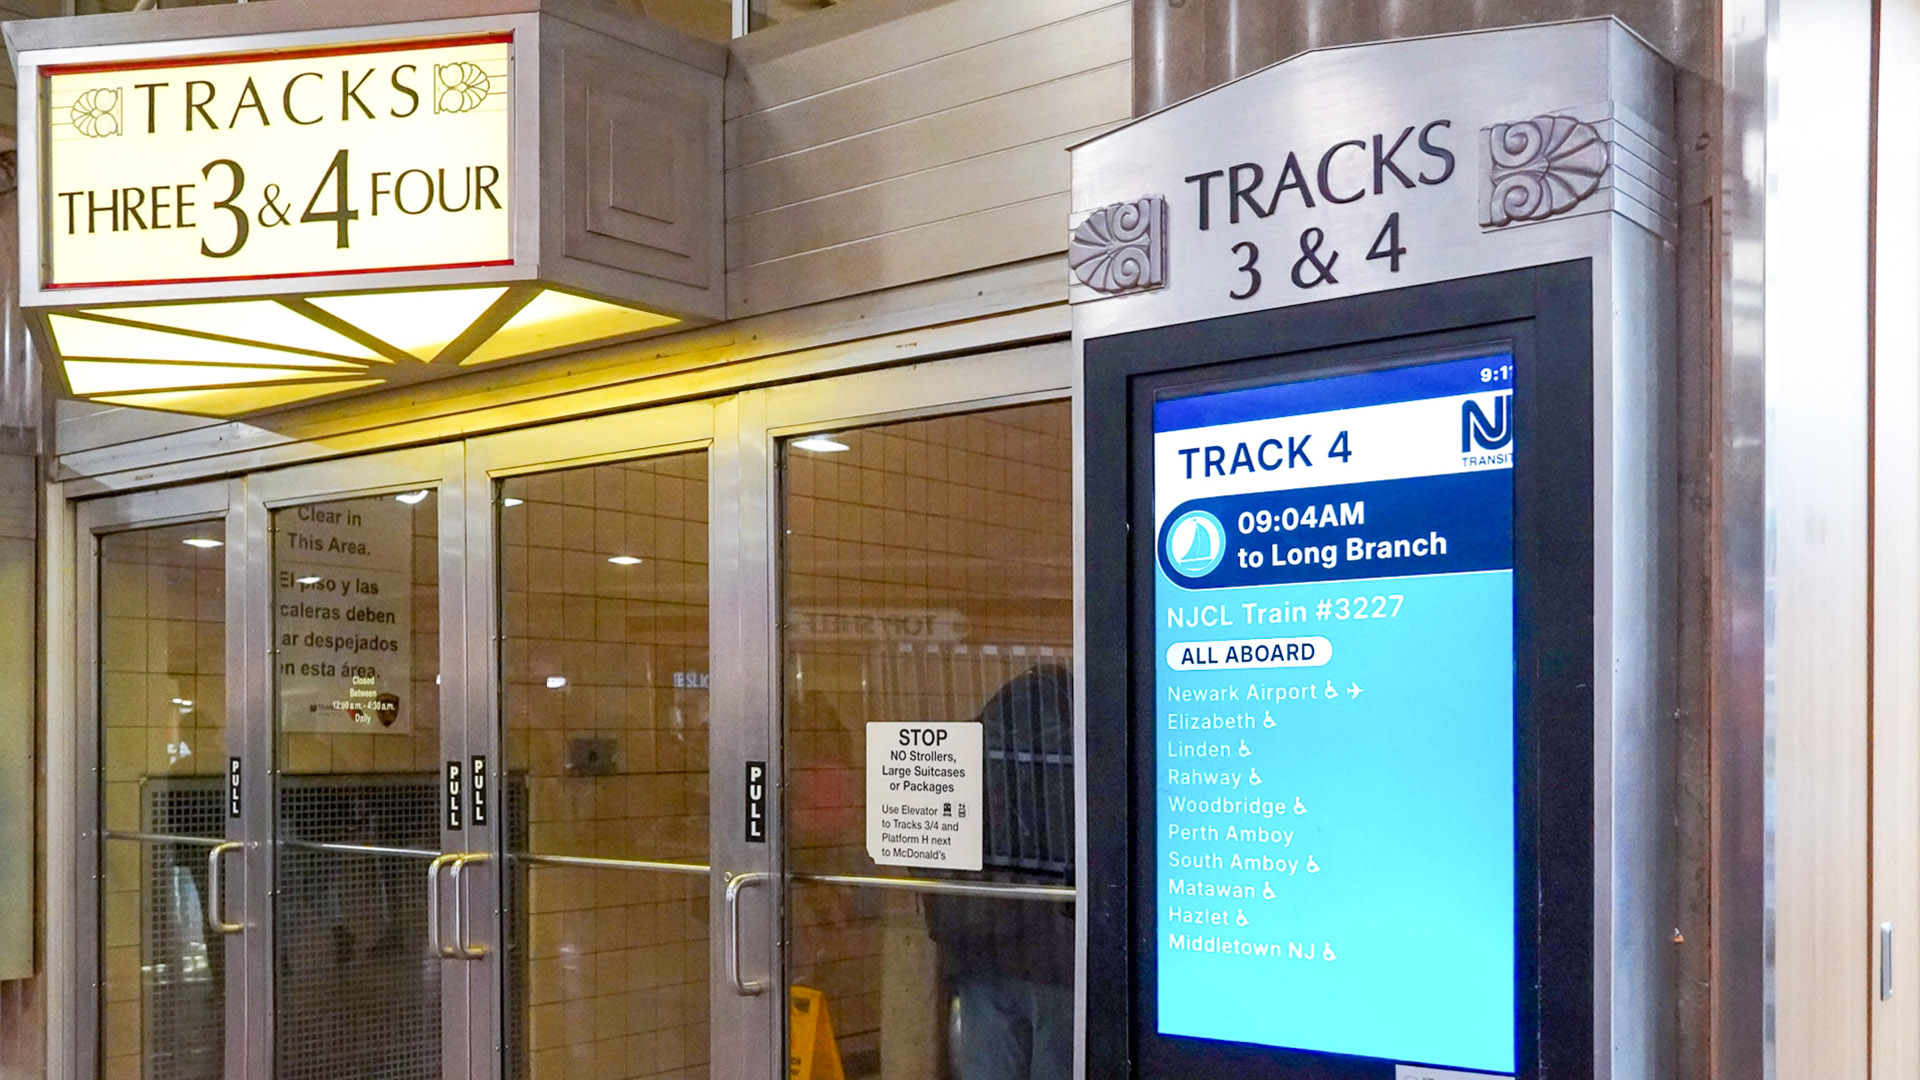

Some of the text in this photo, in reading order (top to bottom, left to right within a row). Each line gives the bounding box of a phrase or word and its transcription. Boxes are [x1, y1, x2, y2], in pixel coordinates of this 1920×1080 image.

[134, 64, 420, 134] TRACKS
[1184, 119, 1455, 231] TRACKS
[58, 149, 502, 259] THREE 3 & 4 FOUR
[1229, 212, 1406, 300] 3 & 4
[1178, 430, 1352, 480] TRACK 4
[298, 506, 361, 526] Clear in
[1237, 501, 1365, 535] 09:04AM
[287, 533, 370, 556] This Area.
[1238, 532, 1447, 569] to Long Branch
[341, 580, 351, 596] y
[356, 577, 379, 594] las
[346, 605, 396, 624] deben
[1167, 594, 1404, 628] NJCL Train #3227
[304, 632, 398, 654] despejados
[1181, 642, 1315, 665] ALL ABOARD
[301, 661, 335, 677] esta
[341, 661, 380, 679] área.
[352, 676, 375, 685] Closed
[349, 688, 377, 698] Between
[1168, 683, 1317, 704] Newark Airport
[355, 713, 371, 725] Daily
[1168, 713, 1256, 730] Elizabeth
[899, 728, 948, 746] STOP
[890, 750, 957, 763] NO Strollers,
[1168, 741, 1231, 758] Linden
[882, 765, 966, 778] Large Suitcases
[1168, 769, 1242, 789] Rahway
[231, 760, 239, 814] PULL
[450, 766, 459, 826] PULL
[475, 760, 484, 821] PULL
[889, 781, 954, 794] or Packages
[750, 766, 762, 837] PULL
[882, 805, 938, 816] Use Elevator
[1168, 796, 1287, 818] Woodbridge
[882, 819, 959, 832] to Tracks 3/4 and
[1168, 824, 1294, 847] Perth Amboy
[882, 833, 951, 846] Platform H next
[882, 848, 946, 860] to McDonald's
[1168, 852, 1299, 876] South Amboy
[1169, 879, 1255, 899] Matawan
[1169, 906, 1229, 925] Hazlet
[1169, 934, 1315, 960] Middletown NJ
